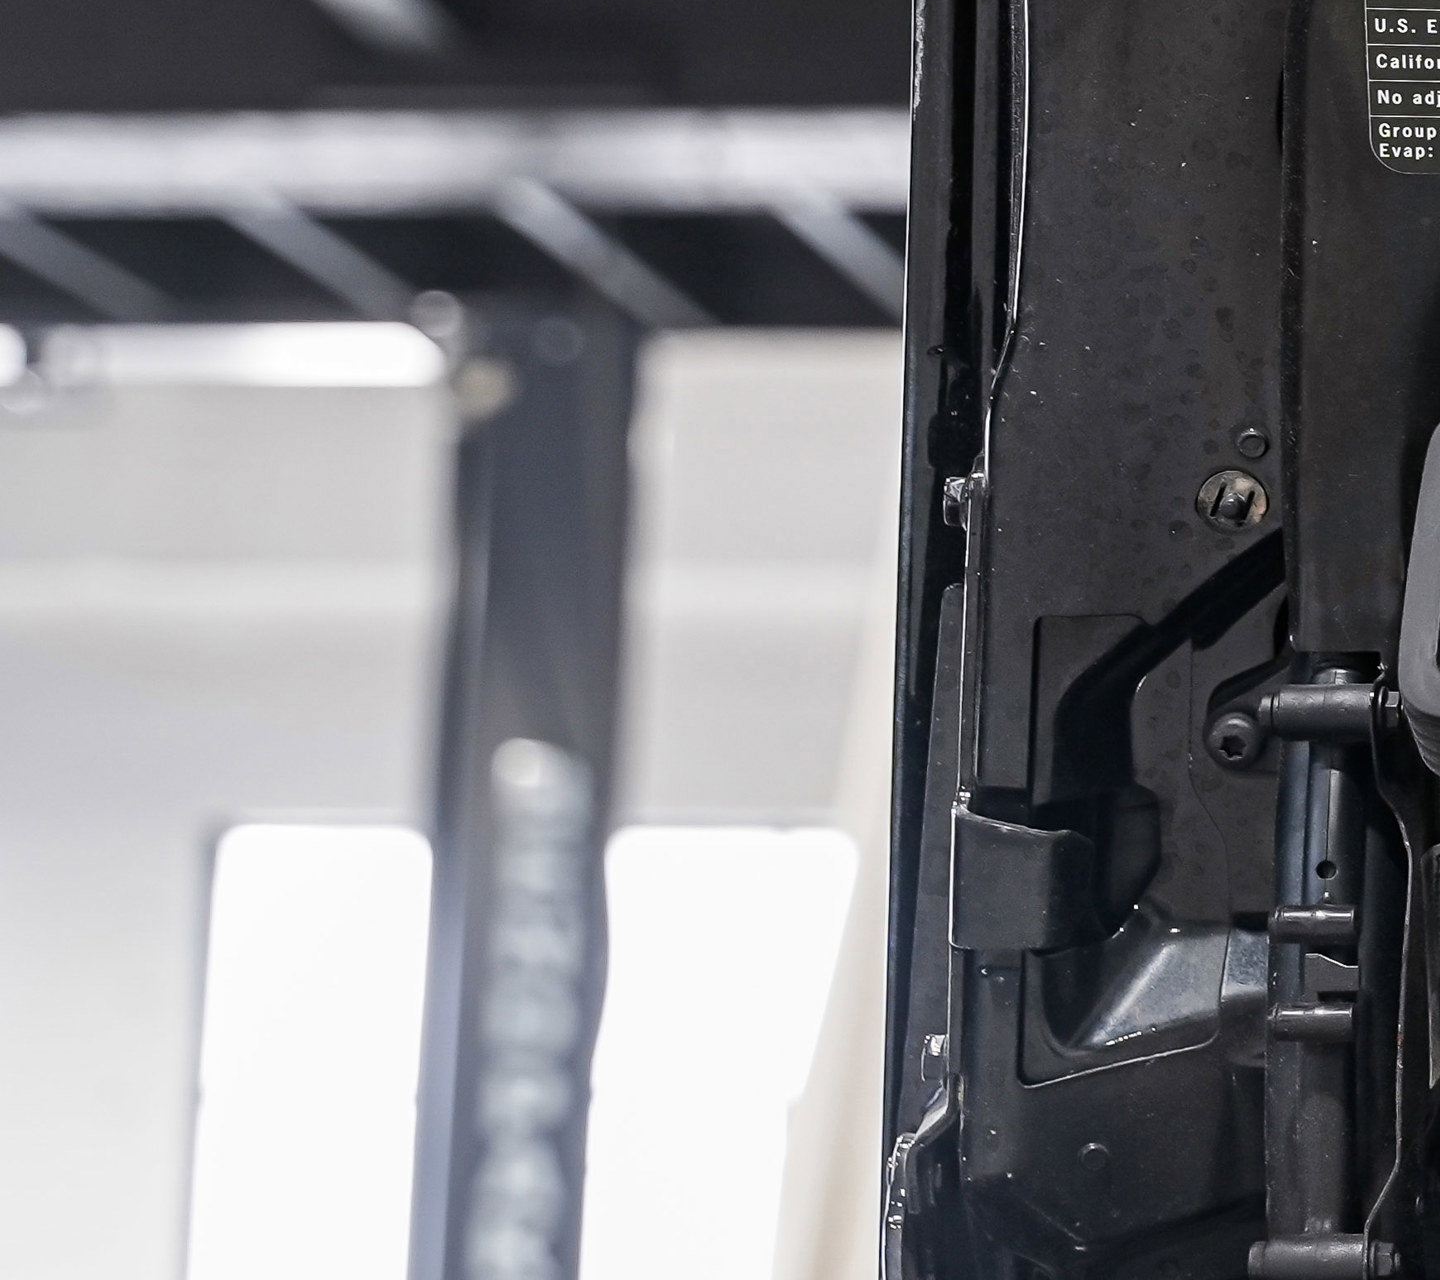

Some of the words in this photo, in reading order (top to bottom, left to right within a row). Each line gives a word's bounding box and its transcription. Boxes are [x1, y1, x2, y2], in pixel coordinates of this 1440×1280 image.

[1375, 18, 1415, 33] U.S.
[1378, 90, 1402, 104] No
[1380, 143, 1433, 160] Evap:
